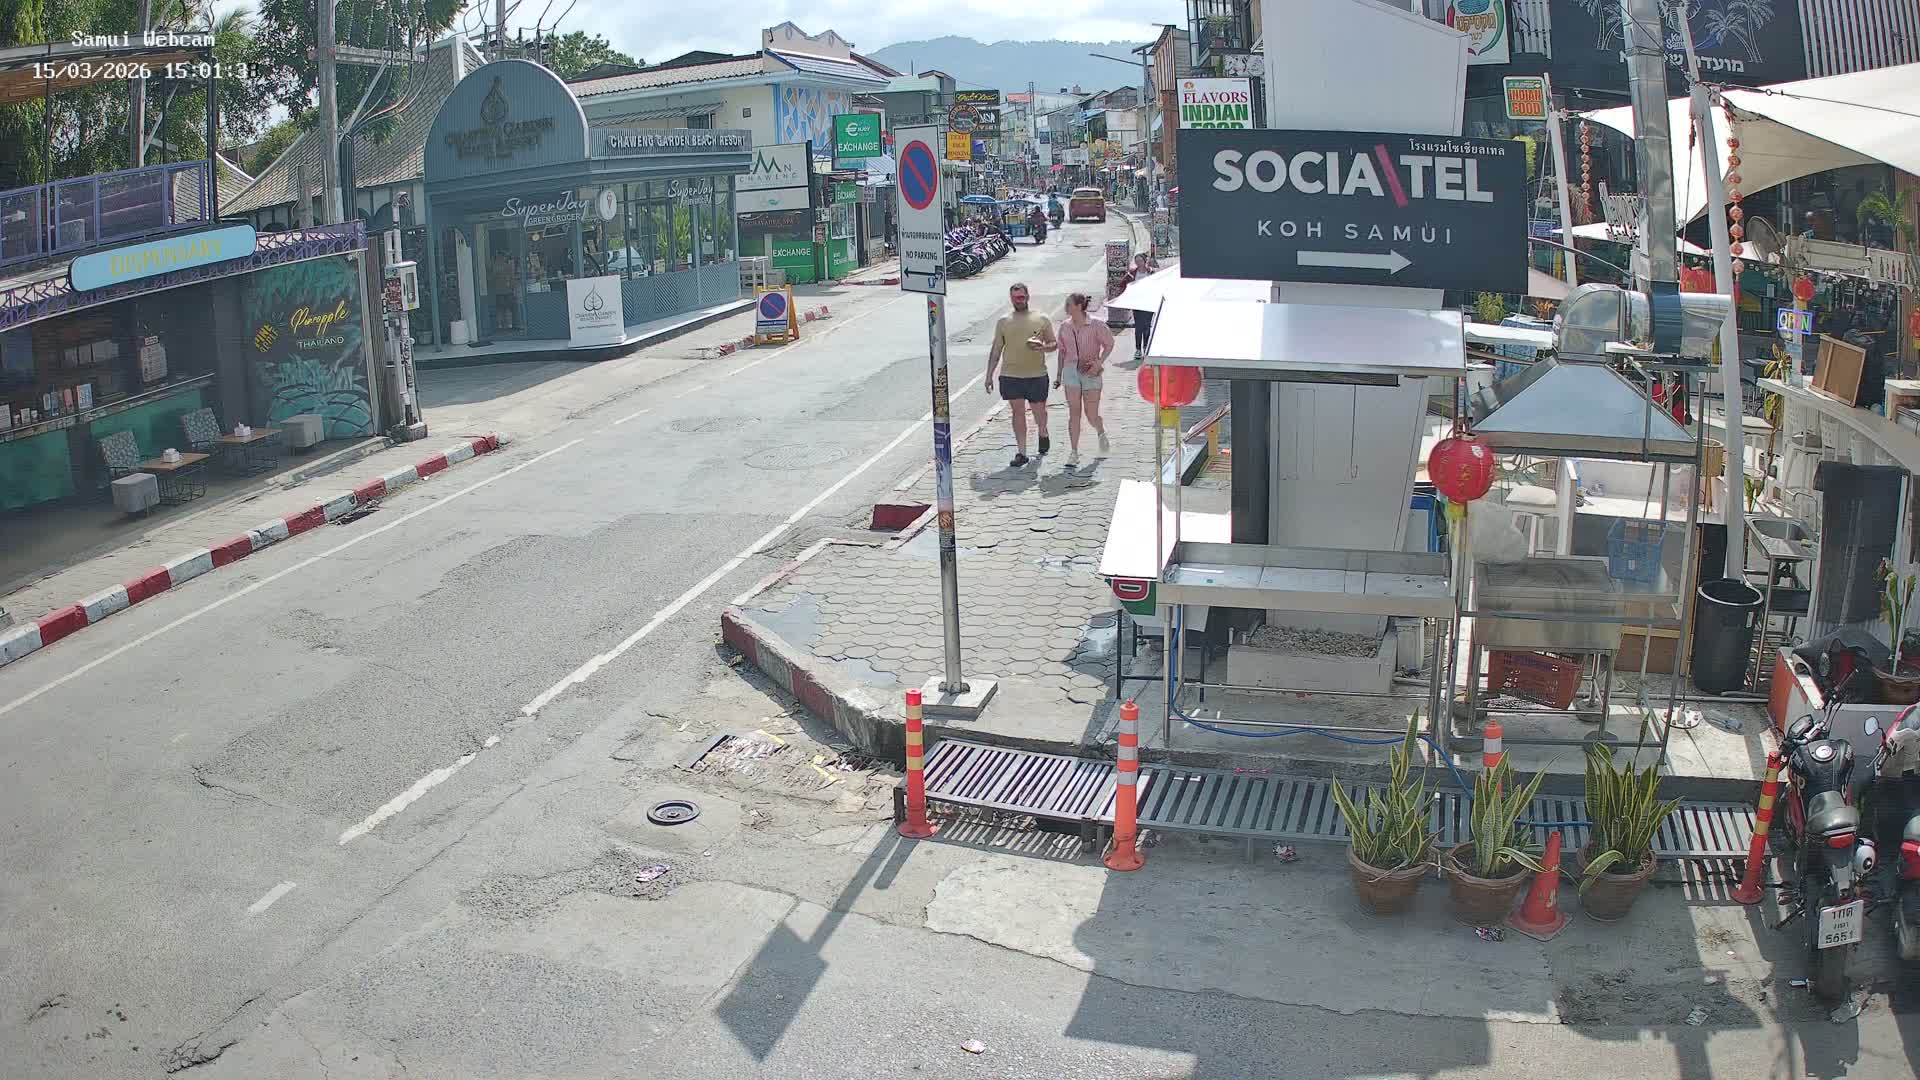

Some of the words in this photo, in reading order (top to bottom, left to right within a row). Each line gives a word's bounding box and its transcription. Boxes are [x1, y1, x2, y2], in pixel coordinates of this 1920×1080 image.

[1183, 92, 1249, 104] FLAVORS
[1508, 89, 1543, 101] INDIAN
[1182, 104, 1249, 121] INDIAN
[1511, 102, 1542, 115] FOOD
[610, 134, 654, 149] CHAWENG
[656, 134, 690, 147] GARDEN
[692, 134, 717, 146] BEACH
[719, 134, 746, 147] RESORT
[838, 142, 879, 153] EXCHANGE
[837, 189, 857, 201] EXCHANGE
[1257, 219, 1322, 238] KOH
[1344, 222, 1451, 244] SAMUI
[110, 239, 223, 277] DISPENSARY
[772, 247, 811, 258] EXCHANGE
[905, 250, 914, 259] NO
[914, 251, 938, 261] PARKING
[297, 336, 345, 349] THAILAND
